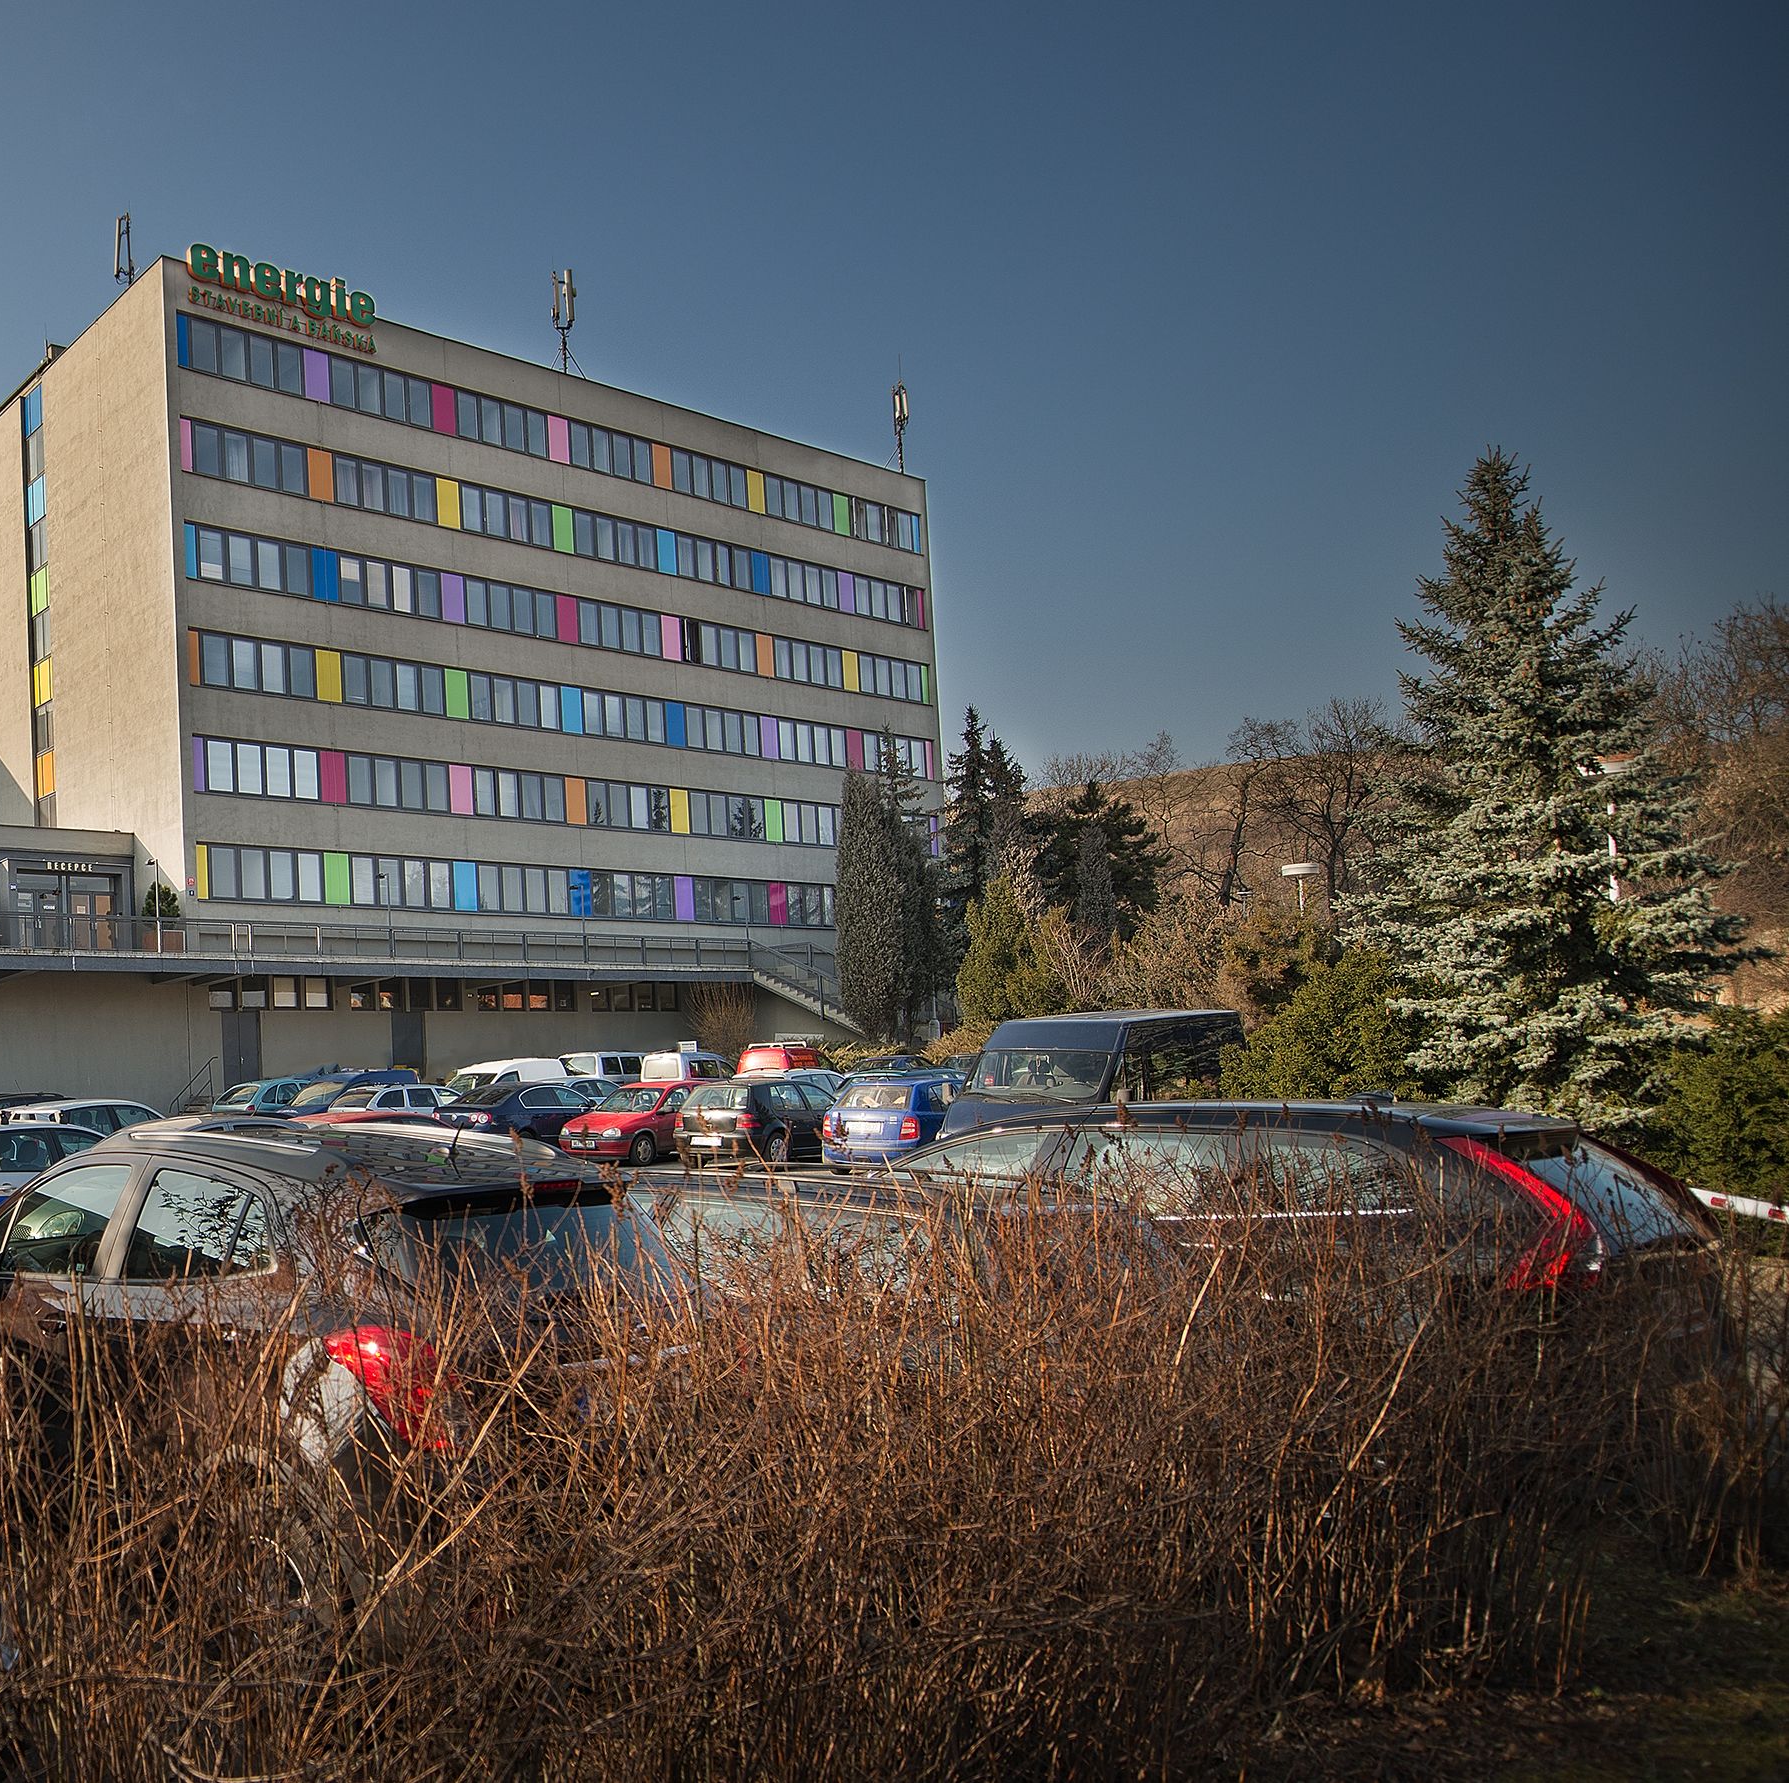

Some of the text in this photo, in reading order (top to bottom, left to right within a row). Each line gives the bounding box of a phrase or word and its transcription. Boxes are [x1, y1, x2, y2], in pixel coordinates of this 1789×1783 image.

[186, 242, 376, 328] energie
[189, 286, 284, 326] STAVEBNÍ
[290, 315, 301, 333] A
[46, 861, 93, 872] RECEPCE
